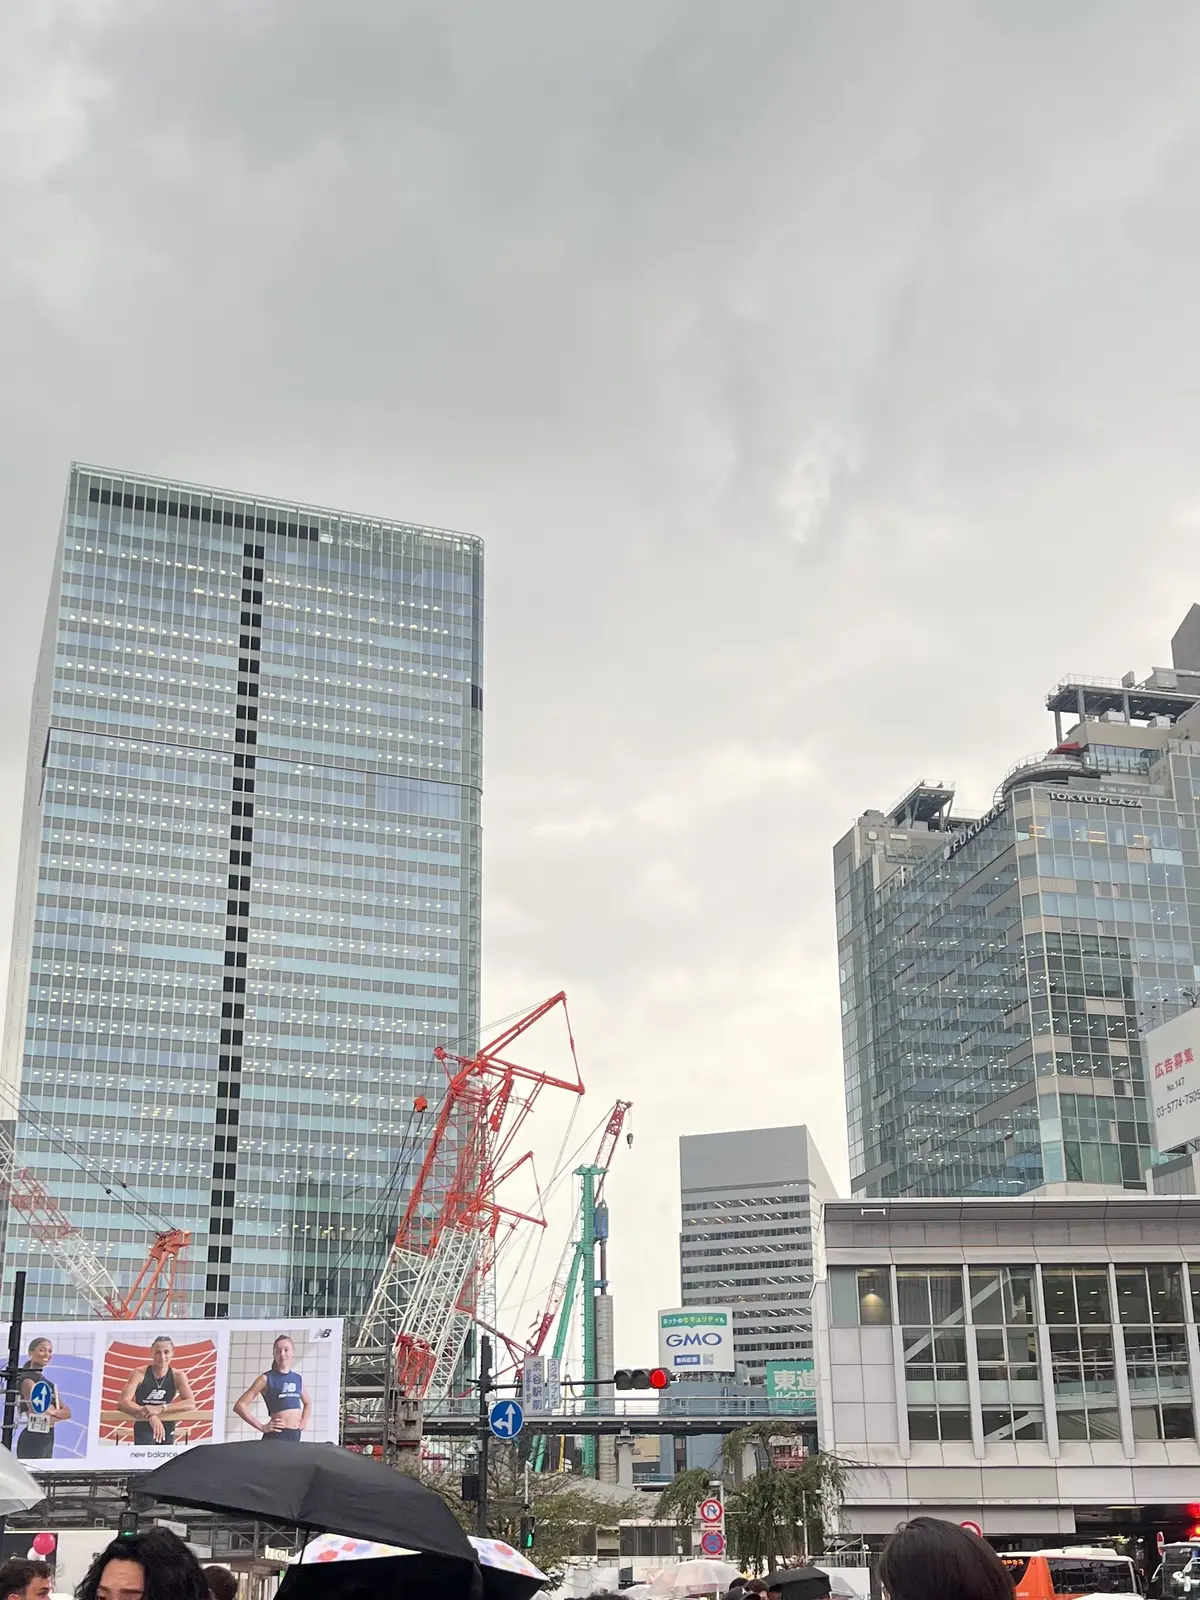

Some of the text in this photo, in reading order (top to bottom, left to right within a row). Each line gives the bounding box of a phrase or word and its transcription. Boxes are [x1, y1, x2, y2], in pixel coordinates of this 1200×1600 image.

[1048, 791, 1144, 807] TOKYU PLAZA
[952, 799, 1006, 852] FUKURAS
[1155, 1048, 1194, 1079] 広告募集
[1167, 1077, 1185, 1092] No.147
[665, 1332, 723, 1348] GMO
[532, 1361, 542, 1410] 渋谷駅前
